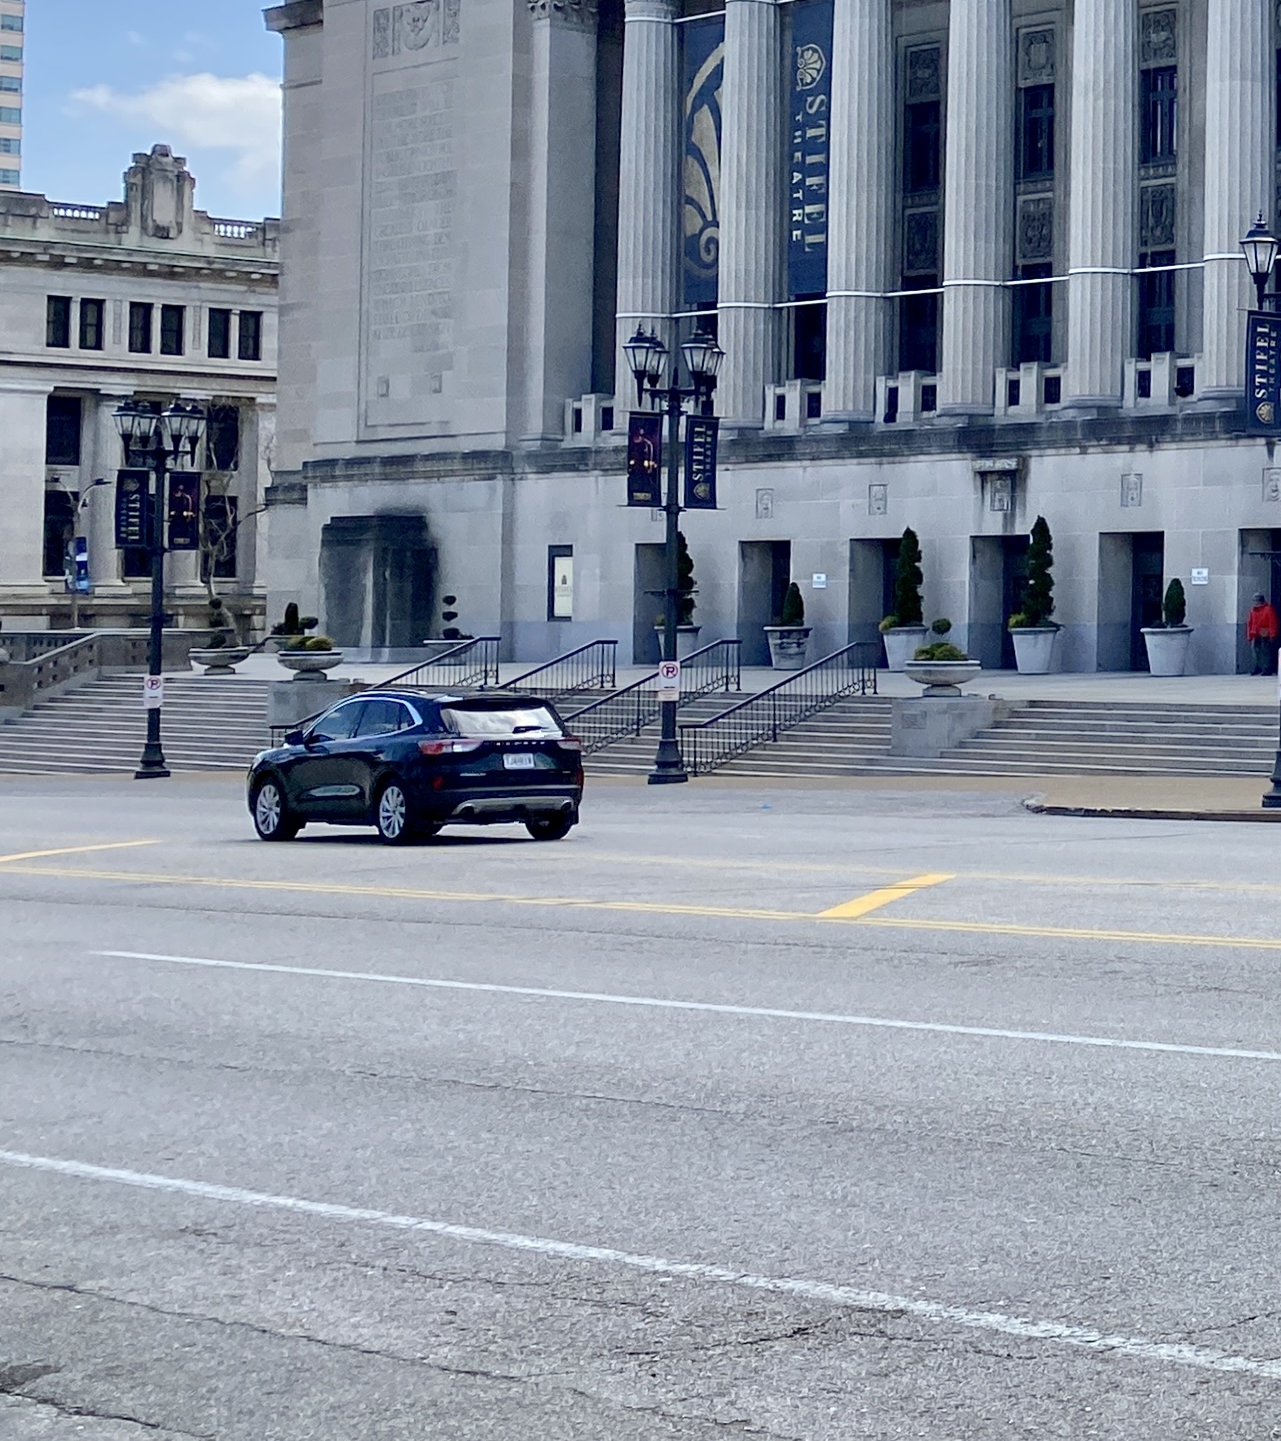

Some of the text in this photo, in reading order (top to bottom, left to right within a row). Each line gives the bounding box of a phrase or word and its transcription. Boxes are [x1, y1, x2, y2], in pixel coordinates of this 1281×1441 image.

[791, 111, 803, 243] THEATRE
[804, 93, 827, 253] STIFEL
[1255, 323, 1270, 399] STIFEL
[692, 424, 706, 482] STIFEL
[127, 493, 140, 542] STIFEL
